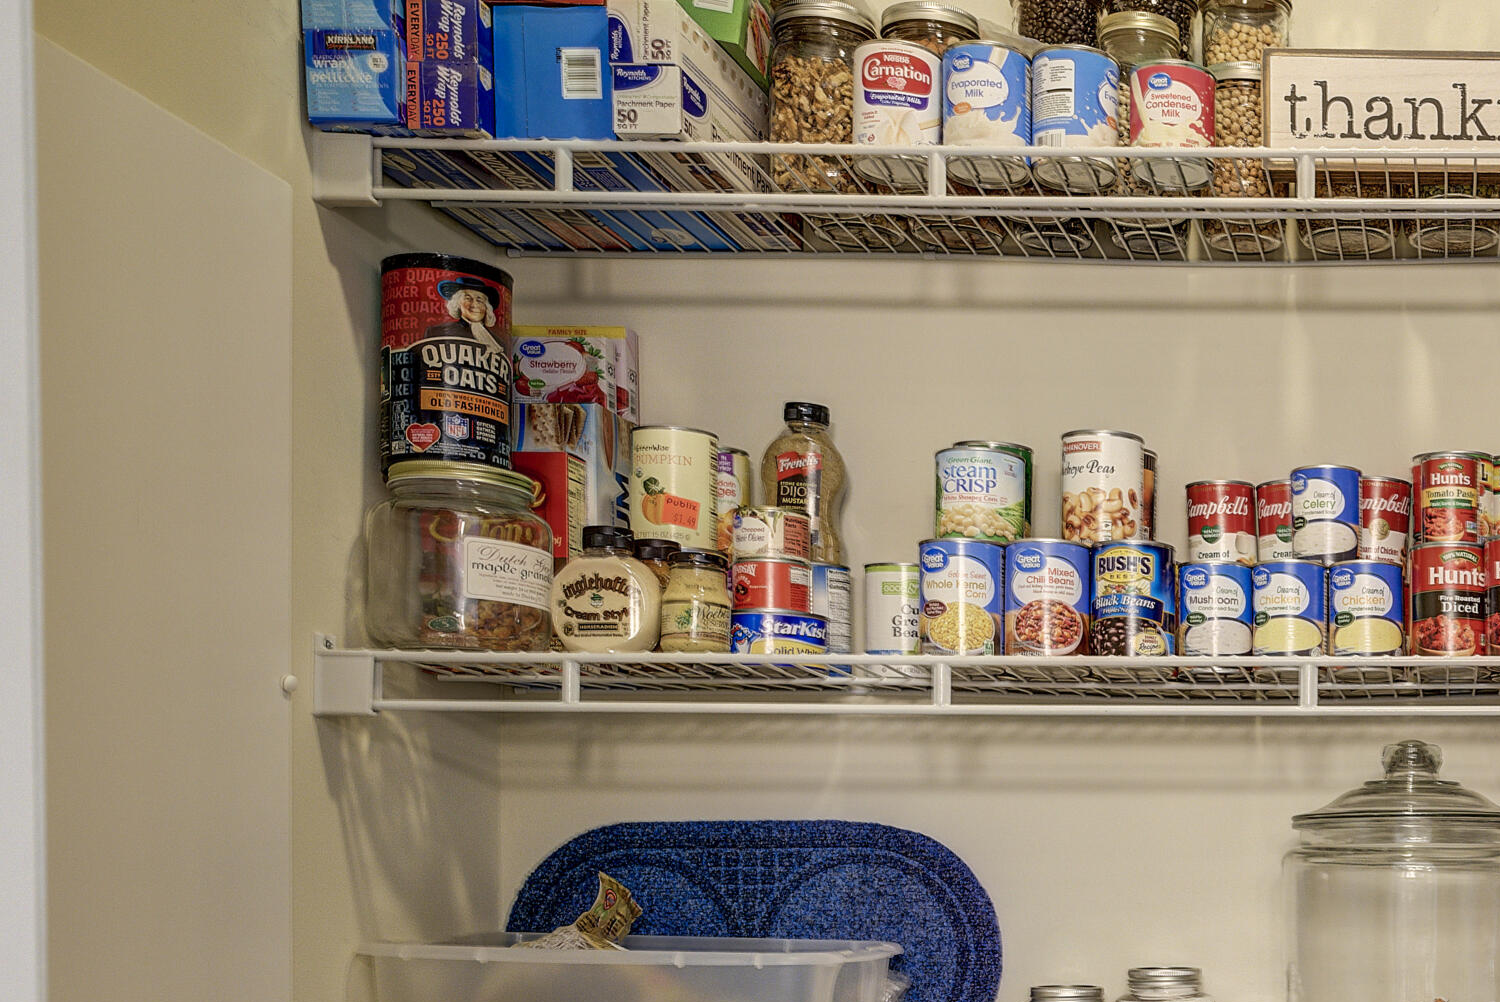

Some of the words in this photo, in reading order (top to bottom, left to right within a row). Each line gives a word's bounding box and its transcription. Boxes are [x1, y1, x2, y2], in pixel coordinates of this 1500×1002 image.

[409, 2, 420, 55] EVERYDAY
[452, 2, 466, 60] Reynolds
[327, 35, 375, 45] KIRKLAND
[435, 33, 449, 60] 250
[651, 39, 665, 60] 50
[864, 58, 930, 85] Carnation
[434, 65, 448, 99] Wrap
[951, 79, 1003, 90] Evaporated
[406, 69, 417, 122] EVERYDAY
[448, 67, 463, 127] Reynolds
[869, 93, 906, 103] Evaporated
[907, 95, 921, 105] Milk
[964, 89, 984, 98] Milk
[617, 100, 654, 108] Parchment
[655, 101, 676, 109] Paper
[1146, 101, 1197, 112] Condensed
[432, 99, 446, 127] 250
[617, 109, 638, 123] 50
[1161, 108, 1180, 118] Milk
[522, 344, 541, 352] Great
[421, 343, 509, 384] QUAKER
[529, 360, 577, 370] Strawberry
[443, 366, 498, 394] OATS
[430, 398, 452, 408] OLD
[454, 401, 505, 420] FASHIONED
[447, 424, 467, 437] NFL
[634, 453, 692, 466] PUMPKIN
[942, 464, 997, 480] steam
[1086, 459, 1115, 475] Peas
[943, 479, 998, 493] CRISP
[1426, 489, 1454, 498] Tomato
[1185, 495, 1248, 520] Campbell's
[1303, 499, 1336, 511] Celery
[673, 512, 697, 527] $1.49
[924, 553, 944, 564] Great
[1017, 554, 1041, 564] Great
[1198, 550, 1219, 559] Cream
[1220, 549, 1230, 558] of
[1455, 550, 1478, 564] NATURAL
[472, 561, 518, 575] maple
[1098, 555, 1152, 576] BUSH'S
[1047, 567, 1075, 578] Mixed
[926, 580, 953, 589] Whole
[1026, 575, 1046, 585] Chili
[1048, 576, 1075, 586] Beans
[965, 589, 987, 599] Corn
[1260, 594, 1301, 605] Chicken
[1342, 594, 1386, 605] Chicken
[1454, 595, 1480, 603] Roasted
[1095, 595, 1120, 610] Black
[1121, 595, 1155, 610] Beans
[1189, 596, 1239, 606] Mushroom
[1441, 601, 1480, 614] Diced
[563, 606, 600, 621] Cream
[761, 618, 828, 639] StarKist
